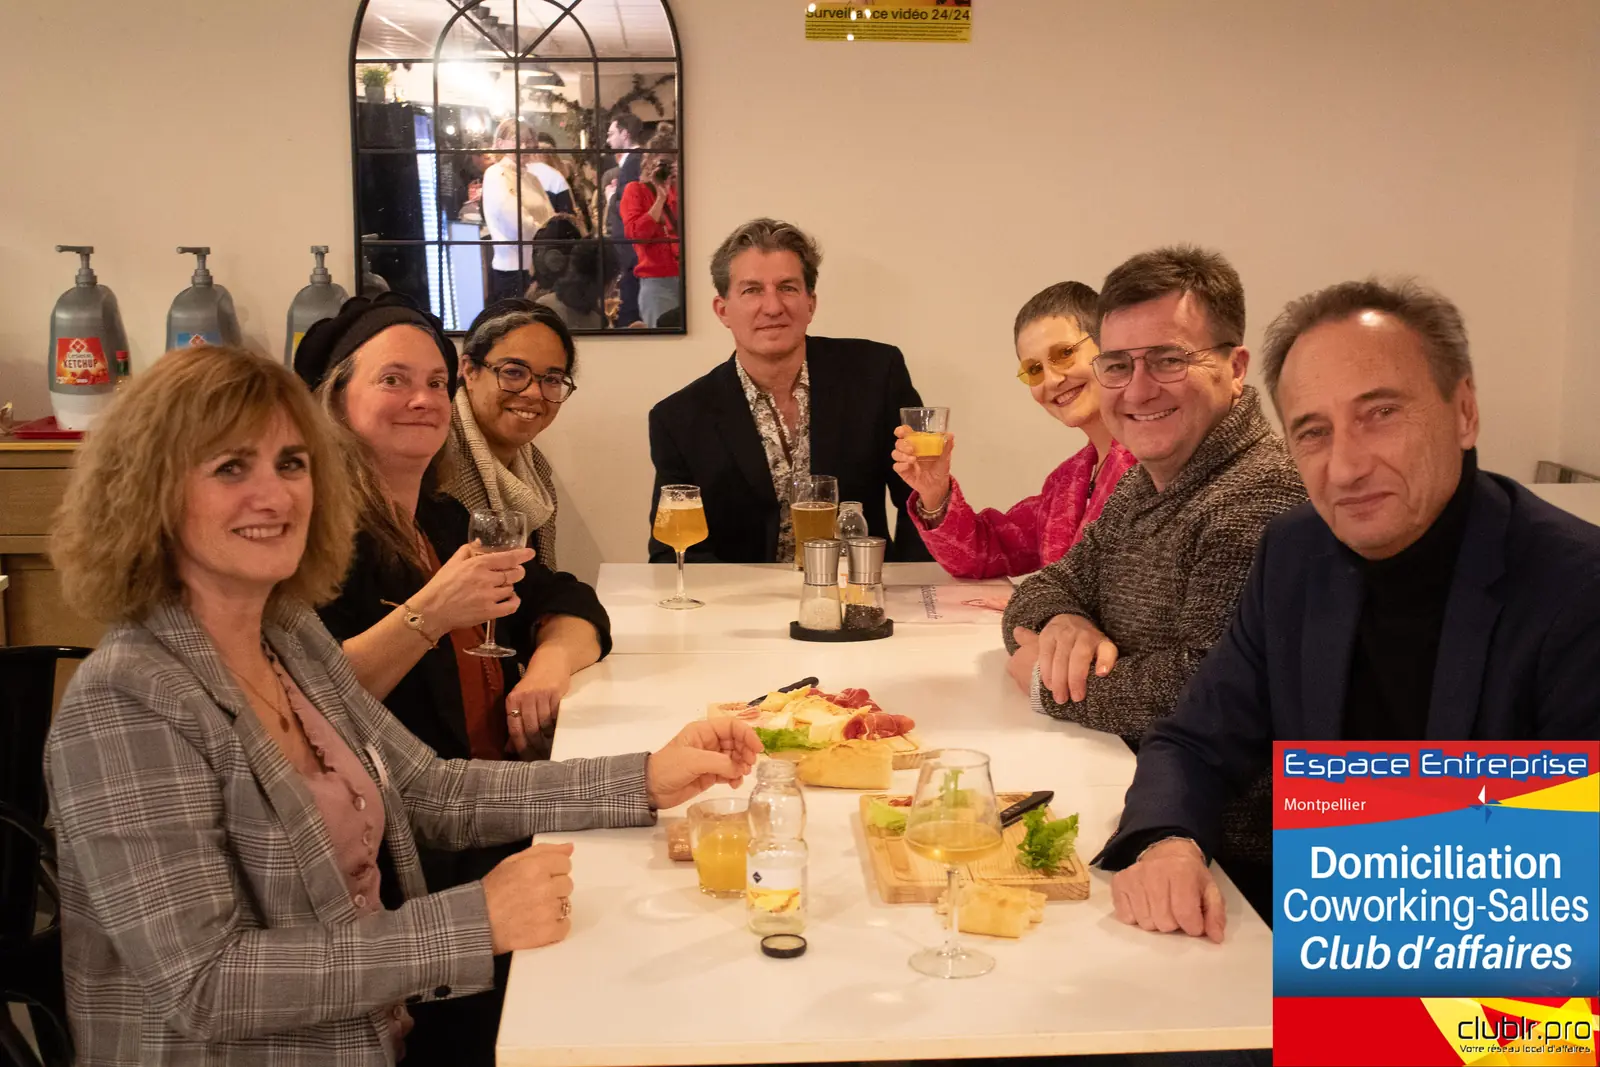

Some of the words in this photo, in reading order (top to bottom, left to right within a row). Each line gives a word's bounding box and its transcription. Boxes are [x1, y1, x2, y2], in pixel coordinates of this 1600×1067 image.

[891, 8, 928, 20] vidéo
[931, 9, 969, 20] 24/24
[63, 359, 97, 368] KETCHUP
